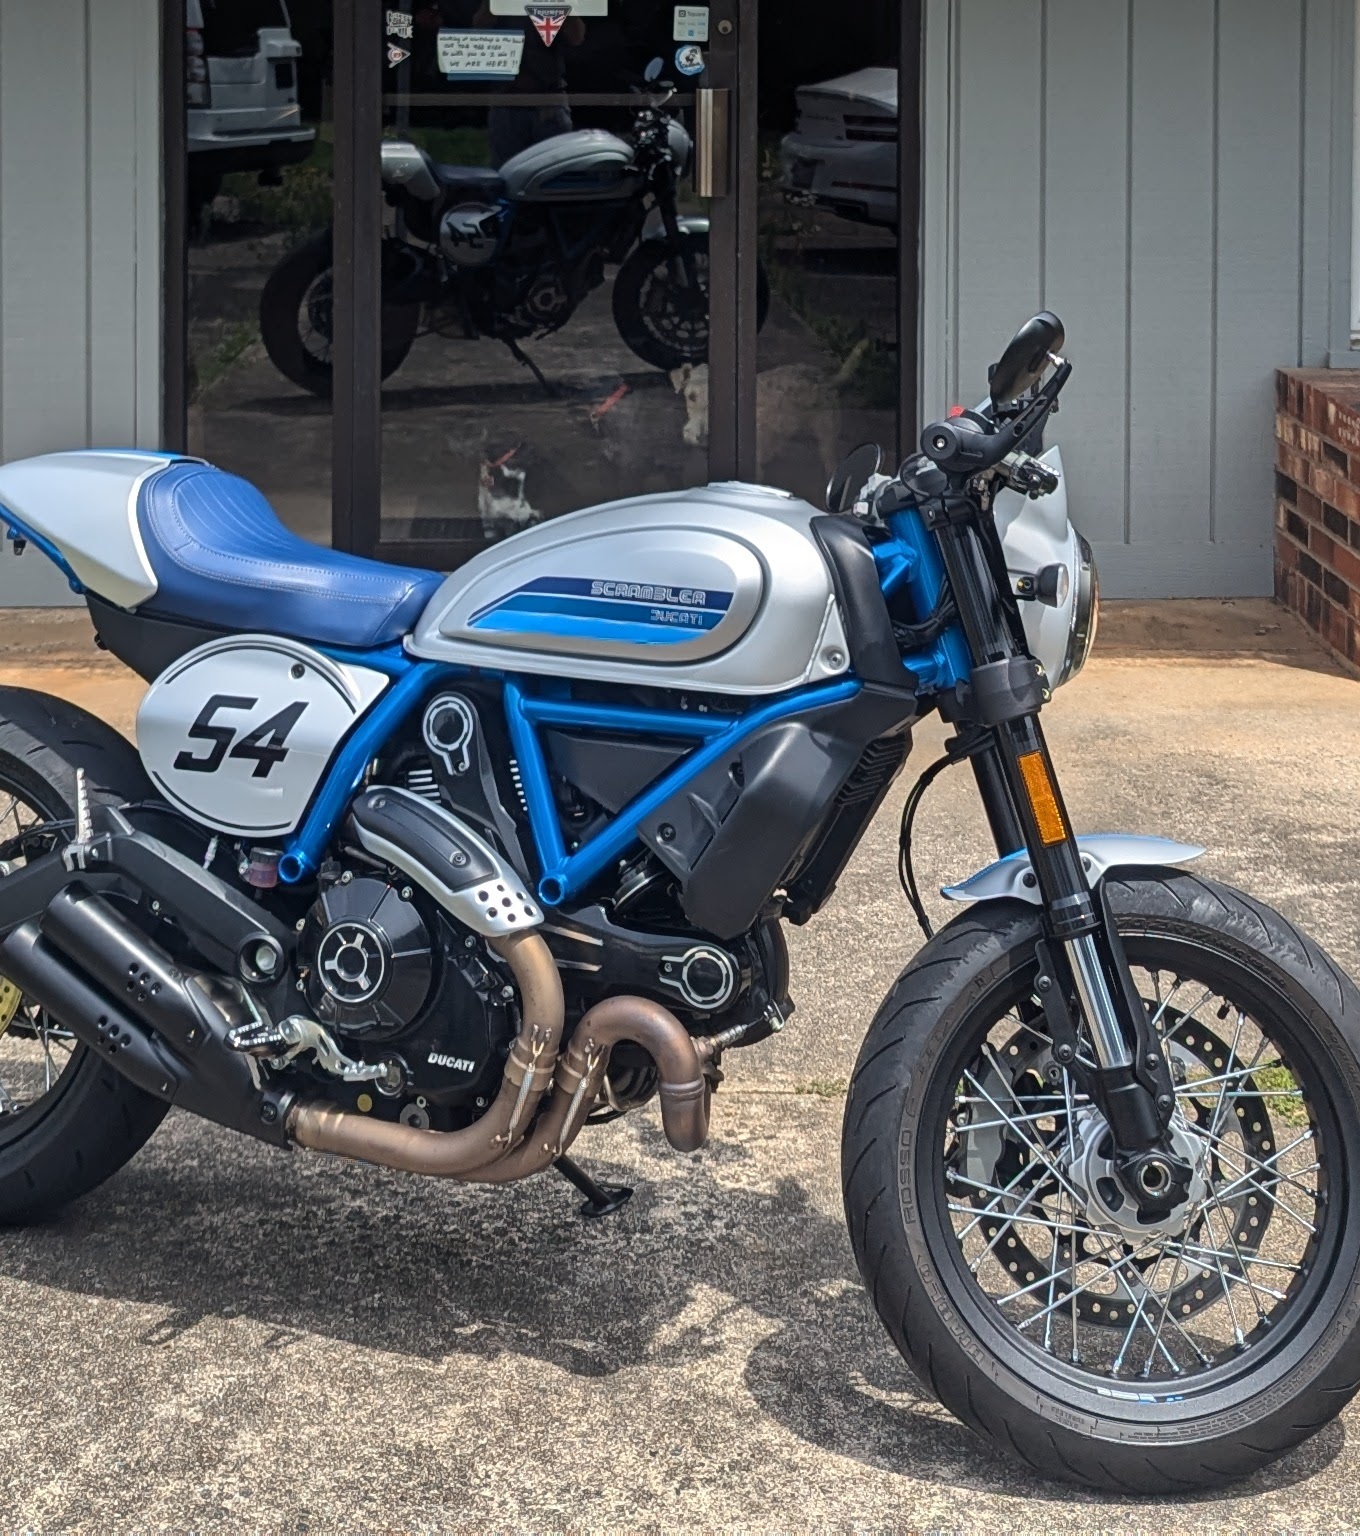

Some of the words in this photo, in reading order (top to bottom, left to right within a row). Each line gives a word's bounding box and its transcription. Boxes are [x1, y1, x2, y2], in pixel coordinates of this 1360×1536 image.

[591, 581, 706, 606] SCRAMBLER
[650, 609, 703, 626] DUCATI
[173, 693, 310, 779] 54
[428, 1052, 475, 1073] DUCATI
[899, 1130, 917, 1224] ROSSO
